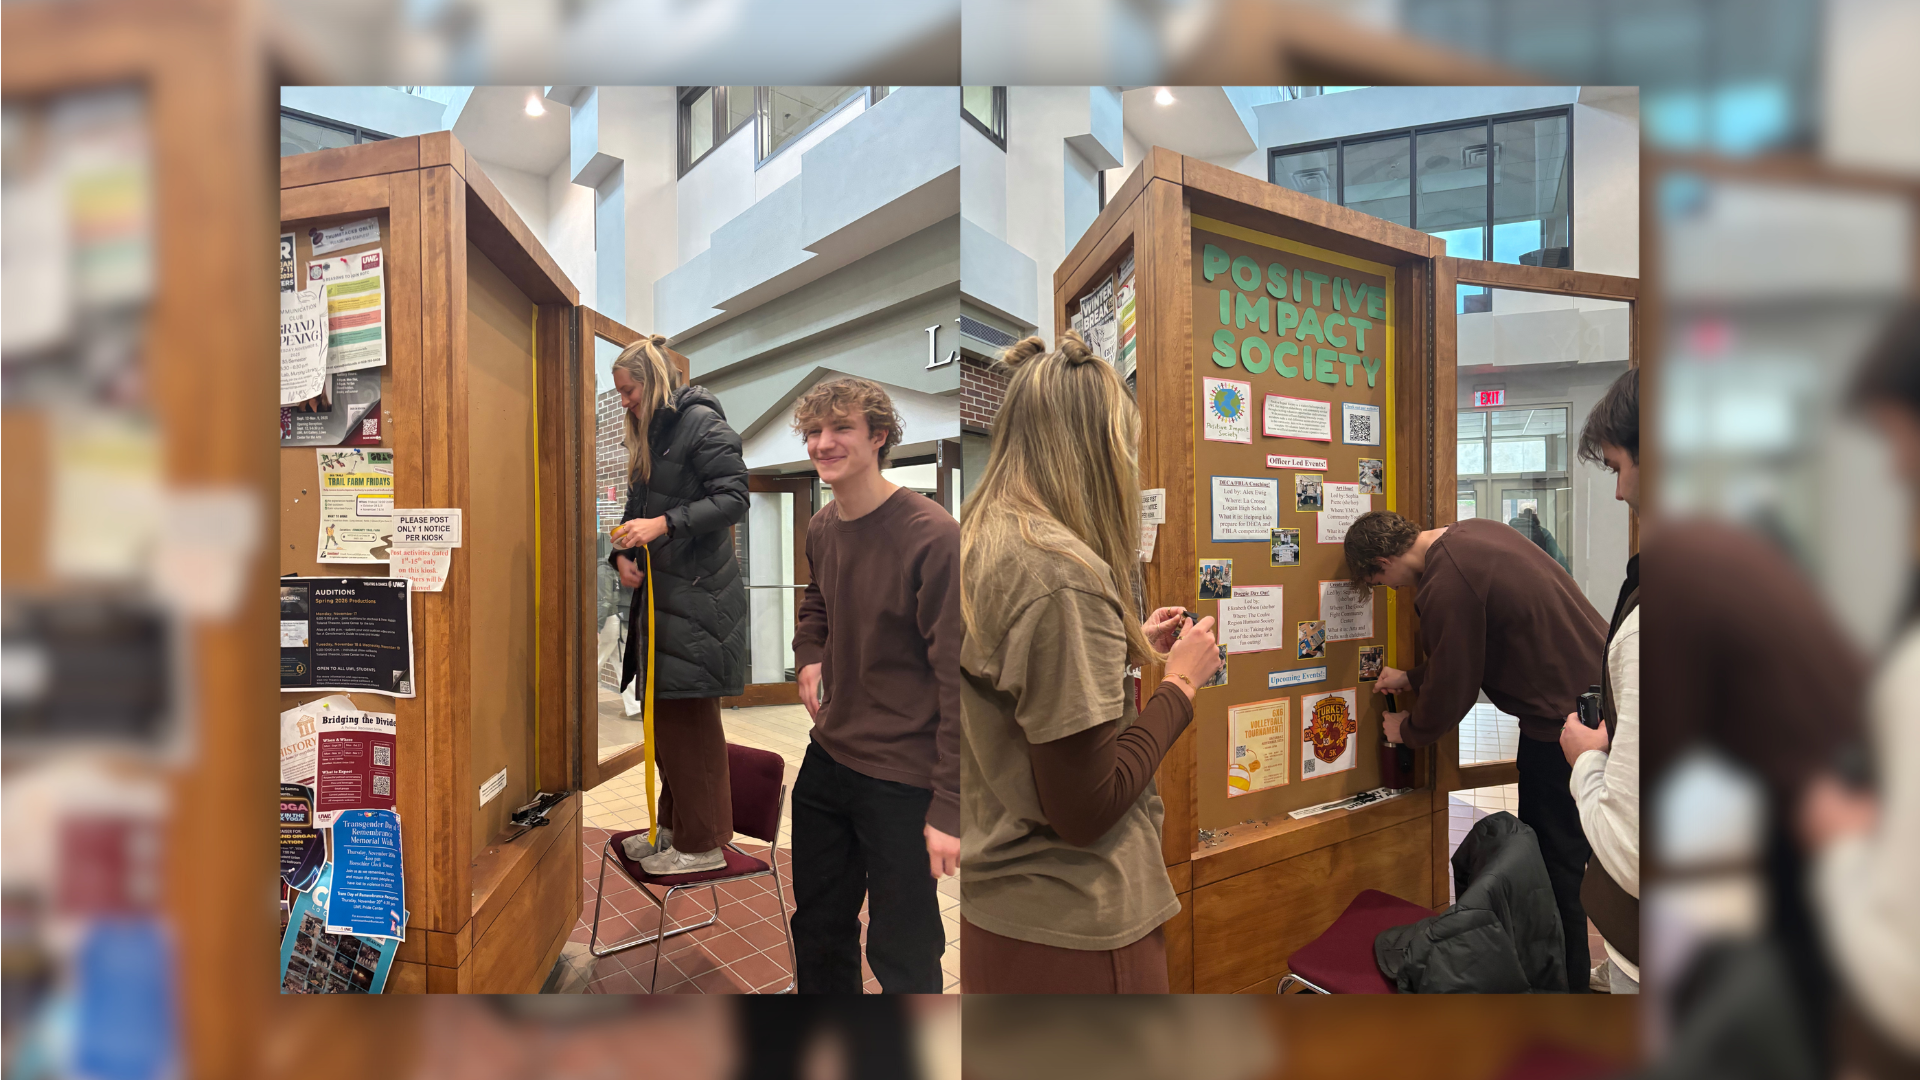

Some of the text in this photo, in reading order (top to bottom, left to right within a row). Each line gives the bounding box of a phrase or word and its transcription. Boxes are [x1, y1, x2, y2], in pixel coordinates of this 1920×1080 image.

[1203, 243, 1386, 320] POSITIVE
[1082, 282, 1112, 316] WINTER
[1084, 300, 1109, 330] BREAK
[1220, 289, 1373, 352] IMPACT
[1212, 329, 1381, 387] SOCIETY
[1481, 391, 1499, 404] EXIT
[1219, 430, 1237, 439] Society
[1229, 425, 1249, 433] Impact
[328, 478, 345, 486] TRAIL
[1271, 674, 1300, 684] Upcoming
[1317, 705, 1345, 717] TURKEY
[322, 716, 358, 725] Bridging
[362, 714, 373, 724] the
[1251, 717, 1283, 729] VOLLEYBALL
[1245, 725, 1283, 738] TOURNAMENT!
[343, 821, 383, 829] Transgender
[352, 828, 393, 837] Remembrance
[351, 836, 393, 846] Memorial Walk
